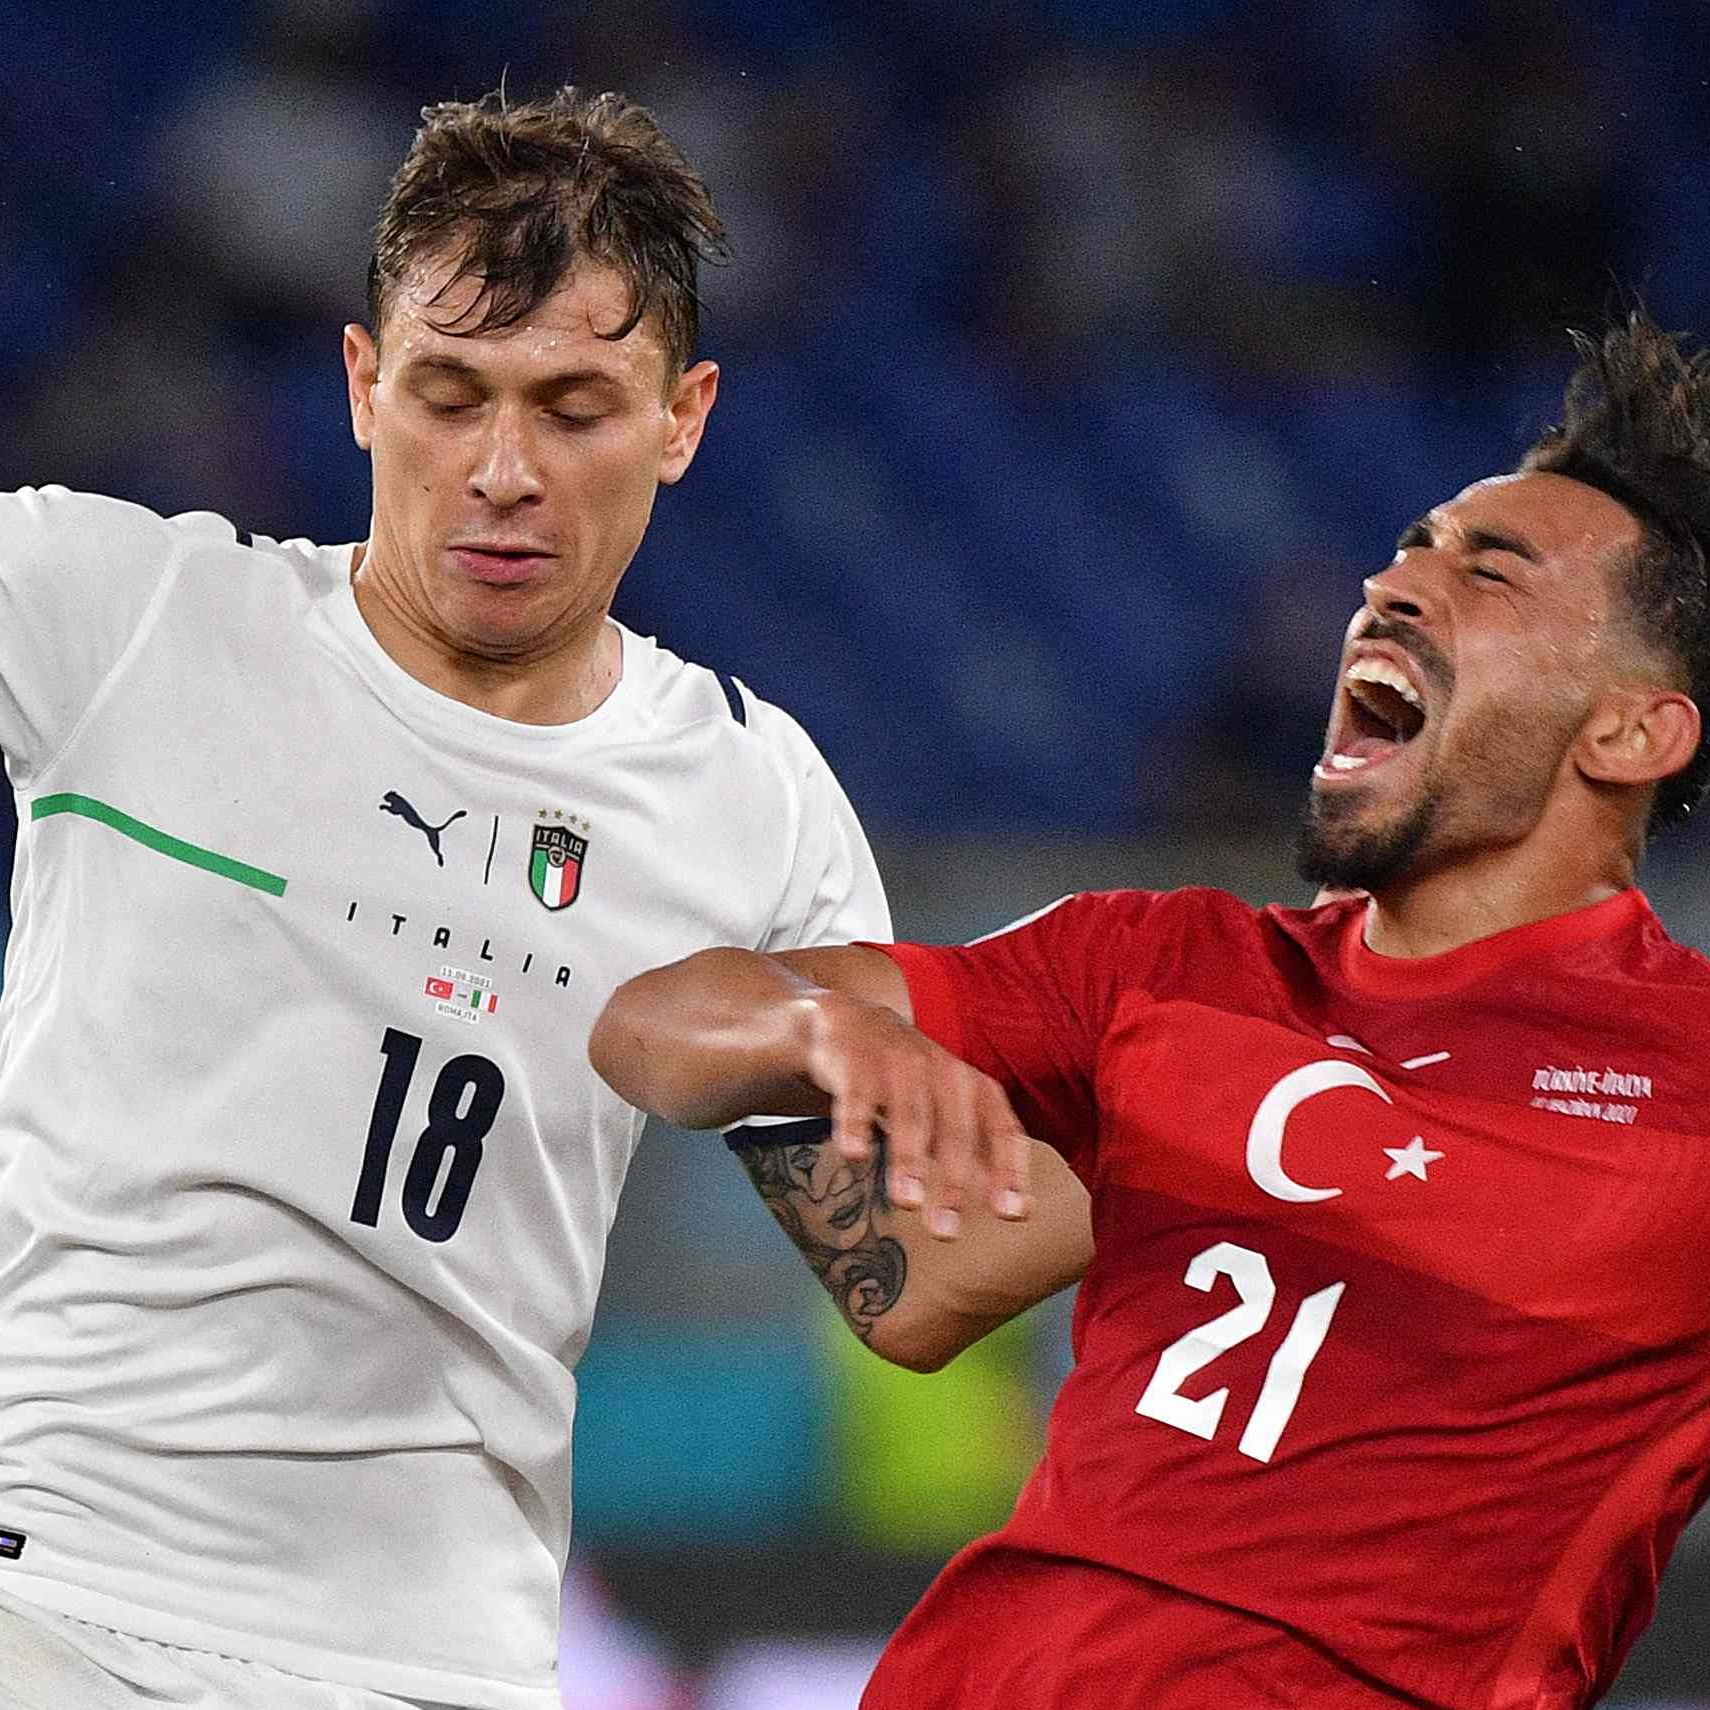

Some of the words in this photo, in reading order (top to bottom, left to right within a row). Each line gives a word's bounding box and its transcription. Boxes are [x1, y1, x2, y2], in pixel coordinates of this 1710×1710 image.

[536, 829, 583, 854] ITALIA
[347, 901, 571, 988] ITALIA
[350, 1026, 505, 1242] 18
[1135, 1241, 1346, 1464] 21
